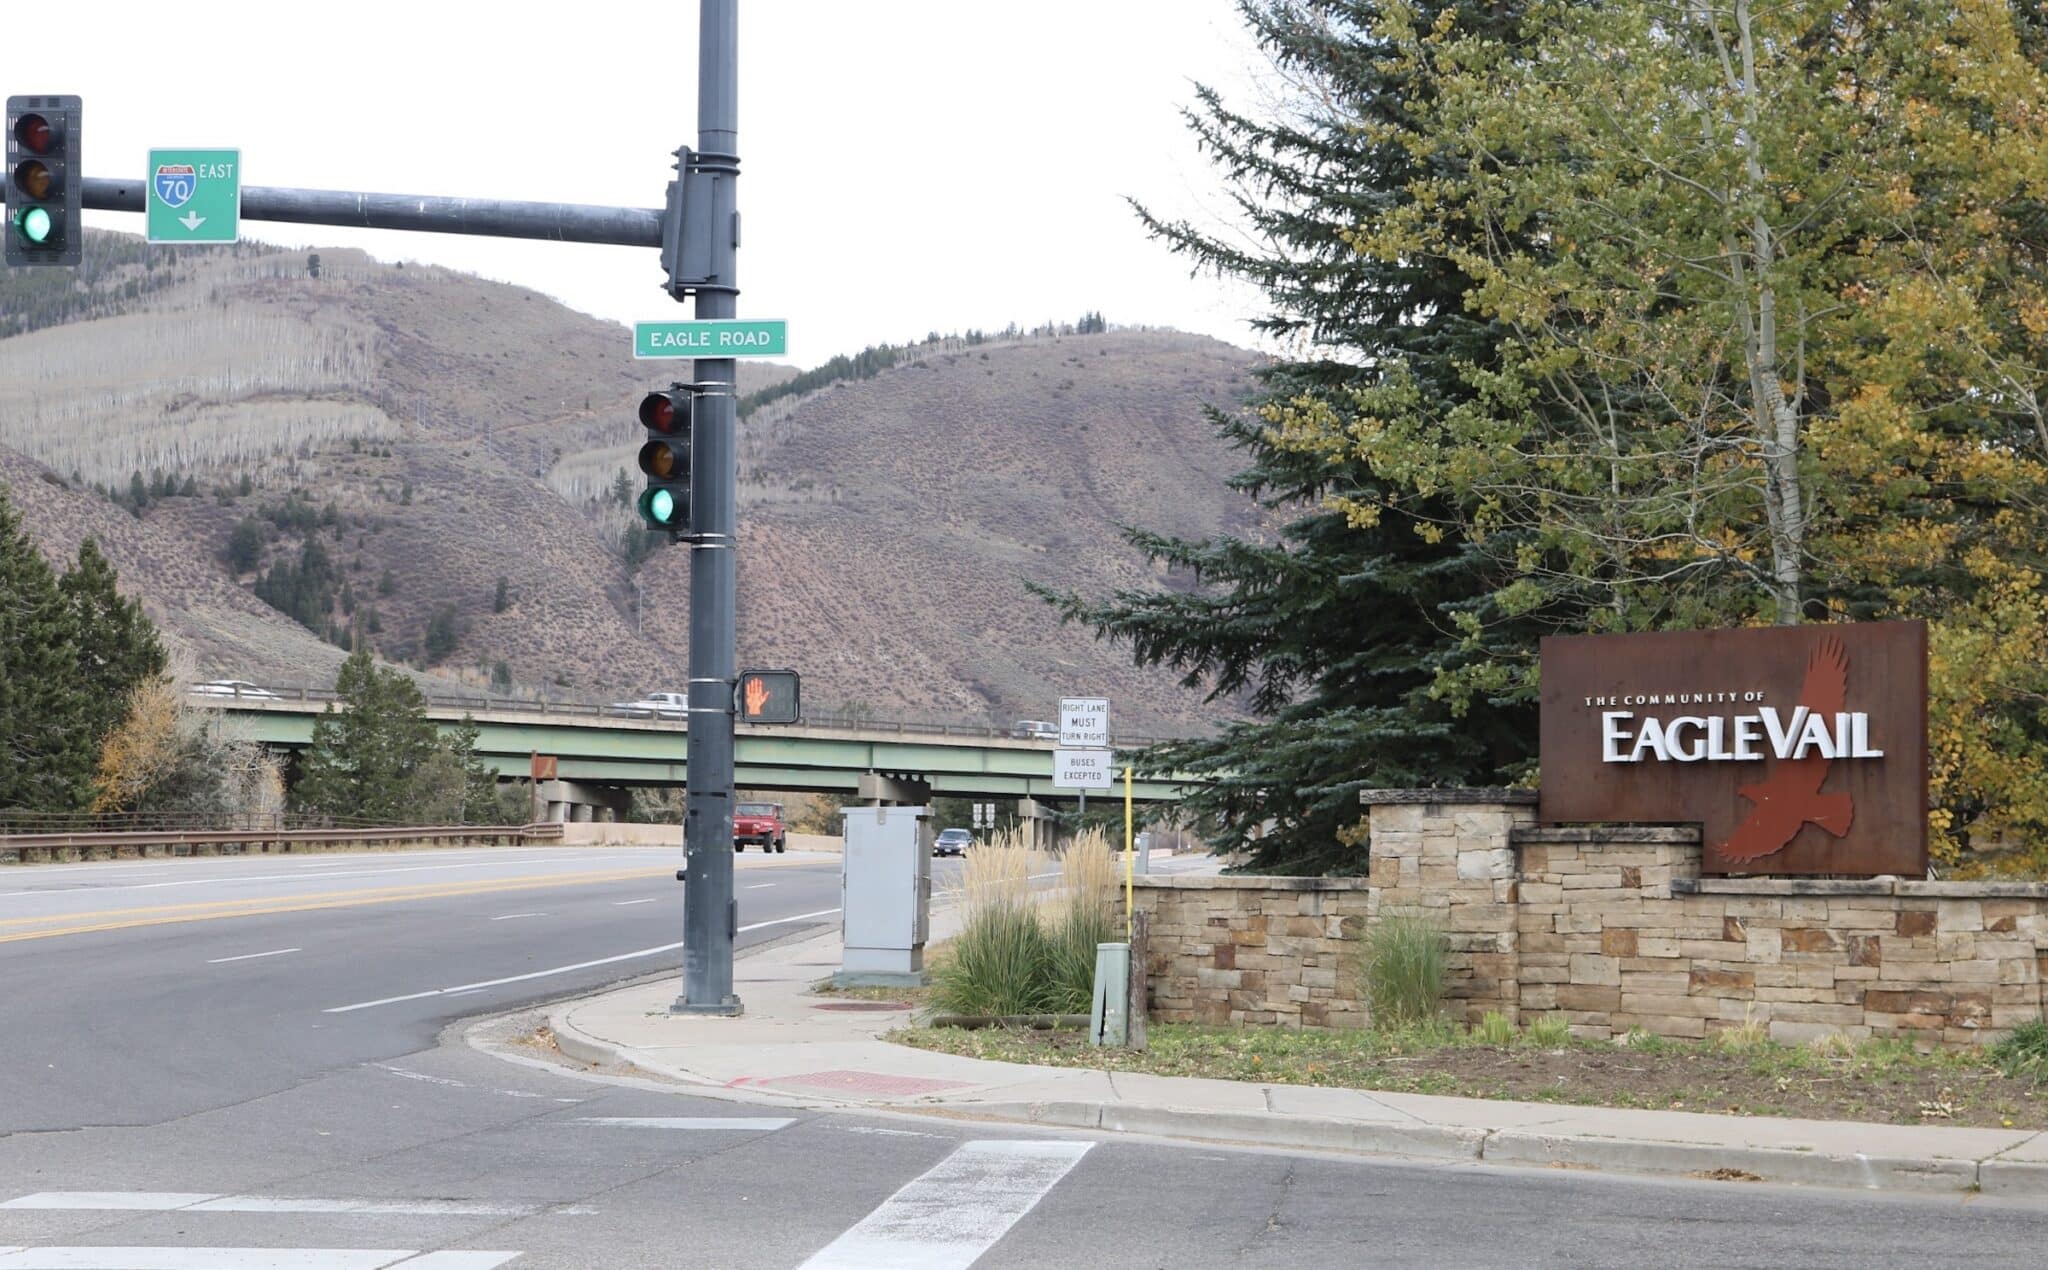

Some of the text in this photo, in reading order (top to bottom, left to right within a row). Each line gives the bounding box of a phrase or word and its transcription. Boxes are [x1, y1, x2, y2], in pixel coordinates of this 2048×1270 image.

[200, 163, 233, 178] EAST
[162, 180, 188, 200] 70
[651, 331, 771, 347] EAGLE ROAD
[1585, 691, 1765, 706] THE COMMUNITY OF
[1063, 704, 1105, 712] RIGHT LANE
[1072, 718, 1096, 727] MUST
[1062, 732, 1105, 741] TURN RIGHT
[1071, 758, 1095, 767] BUSES
[1064, 771, 1101, 780] EXCEPTED
